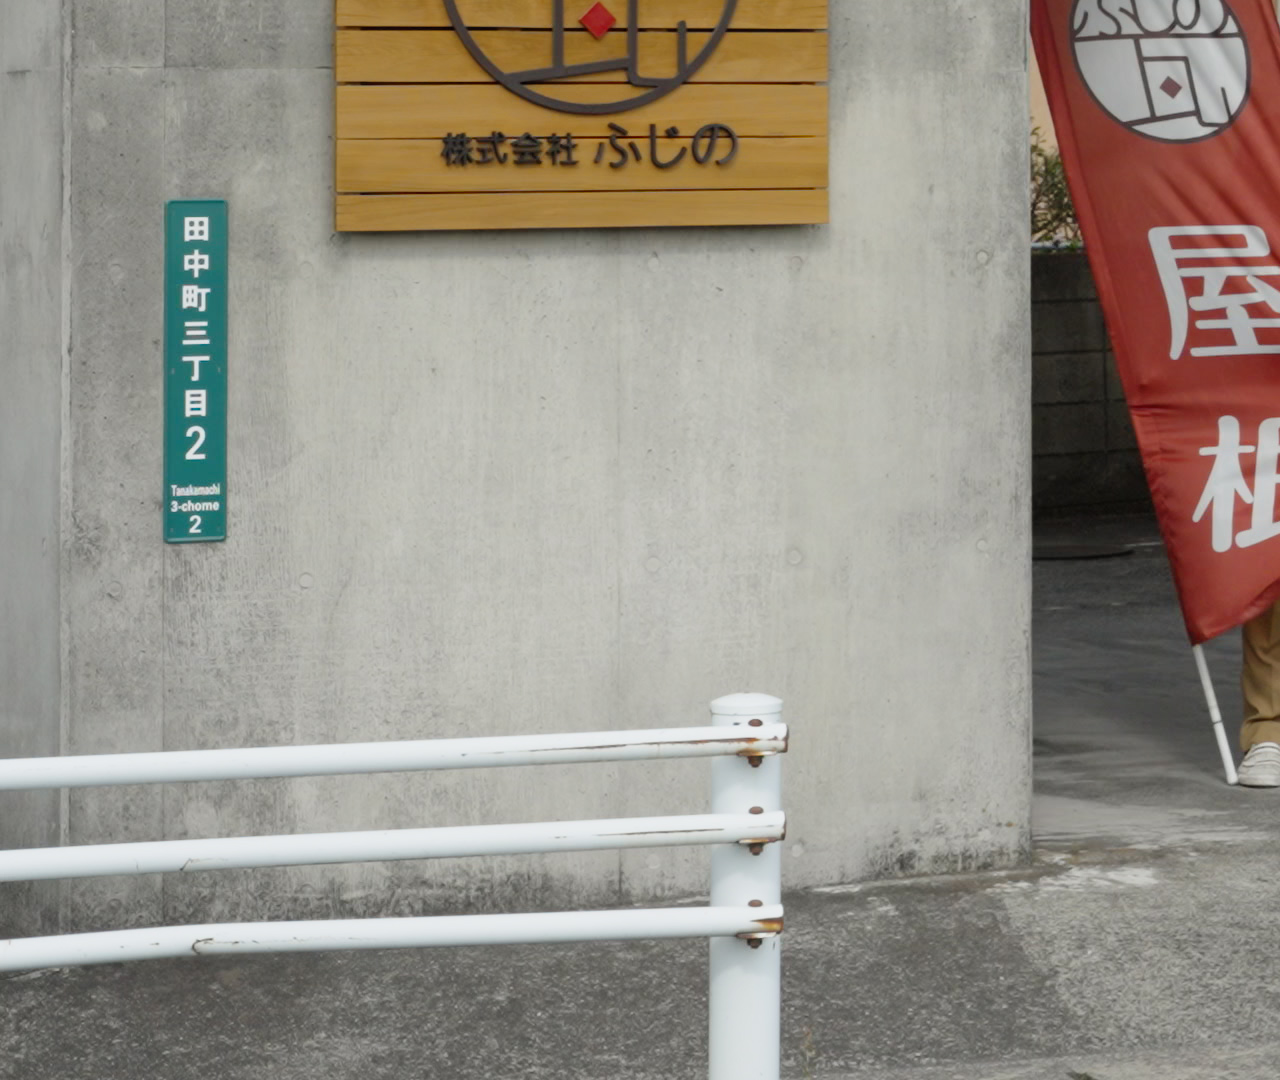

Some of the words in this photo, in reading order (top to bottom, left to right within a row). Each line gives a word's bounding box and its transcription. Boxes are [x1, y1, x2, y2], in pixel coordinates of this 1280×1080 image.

[440, 131, 579, 168] 株式会社
[594, 122, 739, 169] ふじの
[171, 483, 221, 497] Tanakamachi
[170, 500, 220, 513] 3-chome
[189, 515, 202, 534] 2
